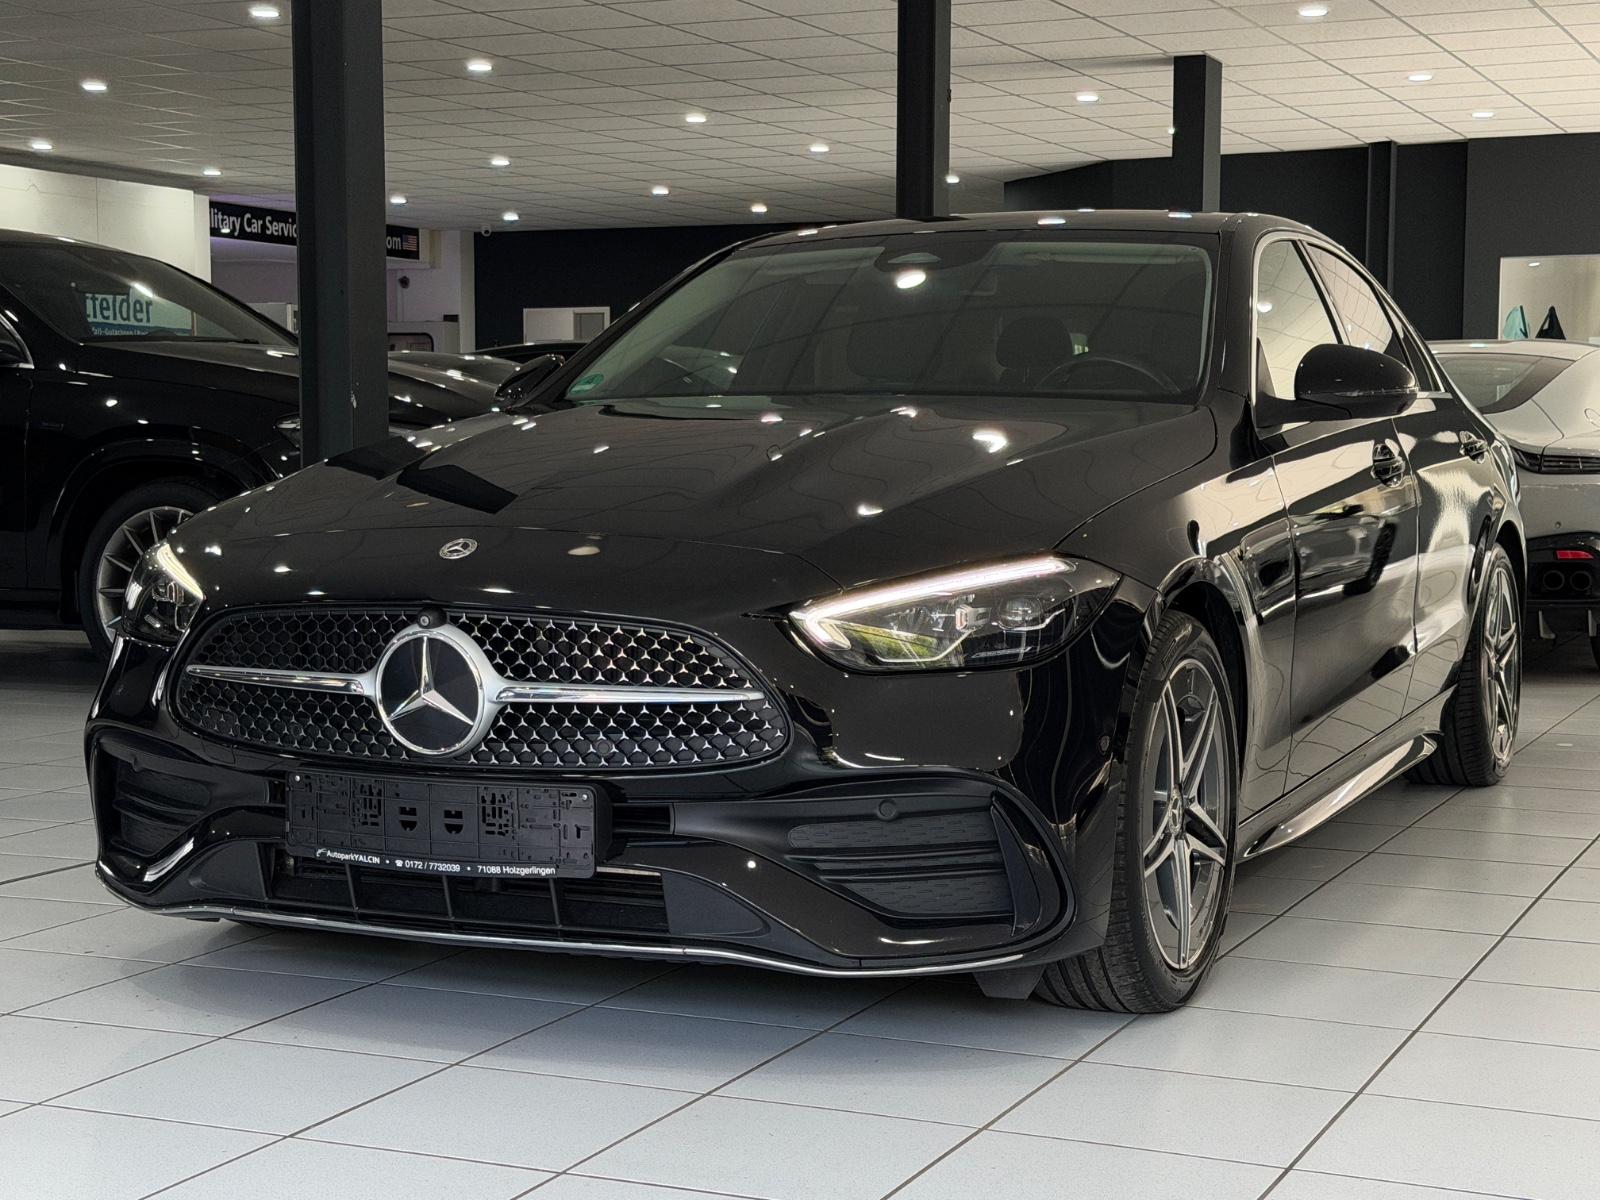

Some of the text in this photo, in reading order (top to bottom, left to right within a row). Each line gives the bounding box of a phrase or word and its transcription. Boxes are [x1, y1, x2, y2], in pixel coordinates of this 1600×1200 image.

[243, 212, 263, 234] Car
[404, 859, 424, 870] 0172
[429, 862, 461, 873] 7732039
[477, 865, 502, 875] 71088
[502, 866, 556, 877] Holzgerlingen
